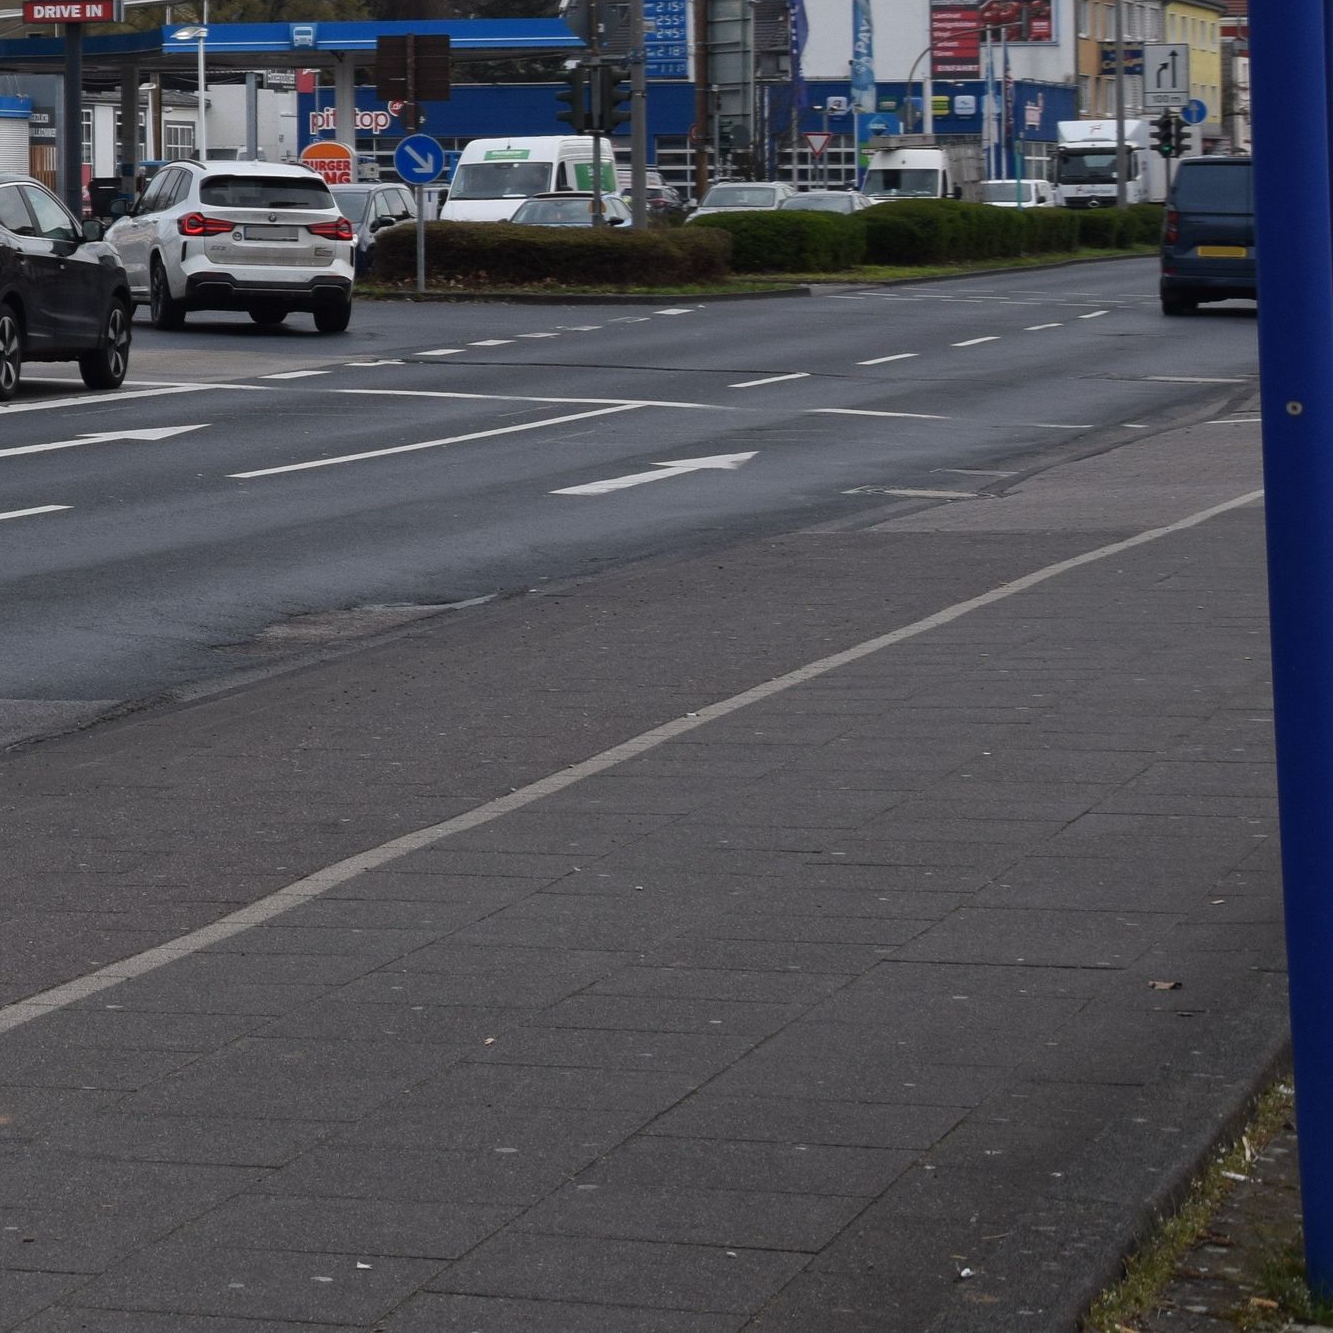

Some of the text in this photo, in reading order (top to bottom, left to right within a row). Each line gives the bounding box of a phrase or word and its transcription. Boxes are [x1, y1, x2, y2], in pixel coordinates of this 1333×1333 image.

[34, 4, 103, 19] DRIVE IN
[1153, 94, 1170, 103] 100
